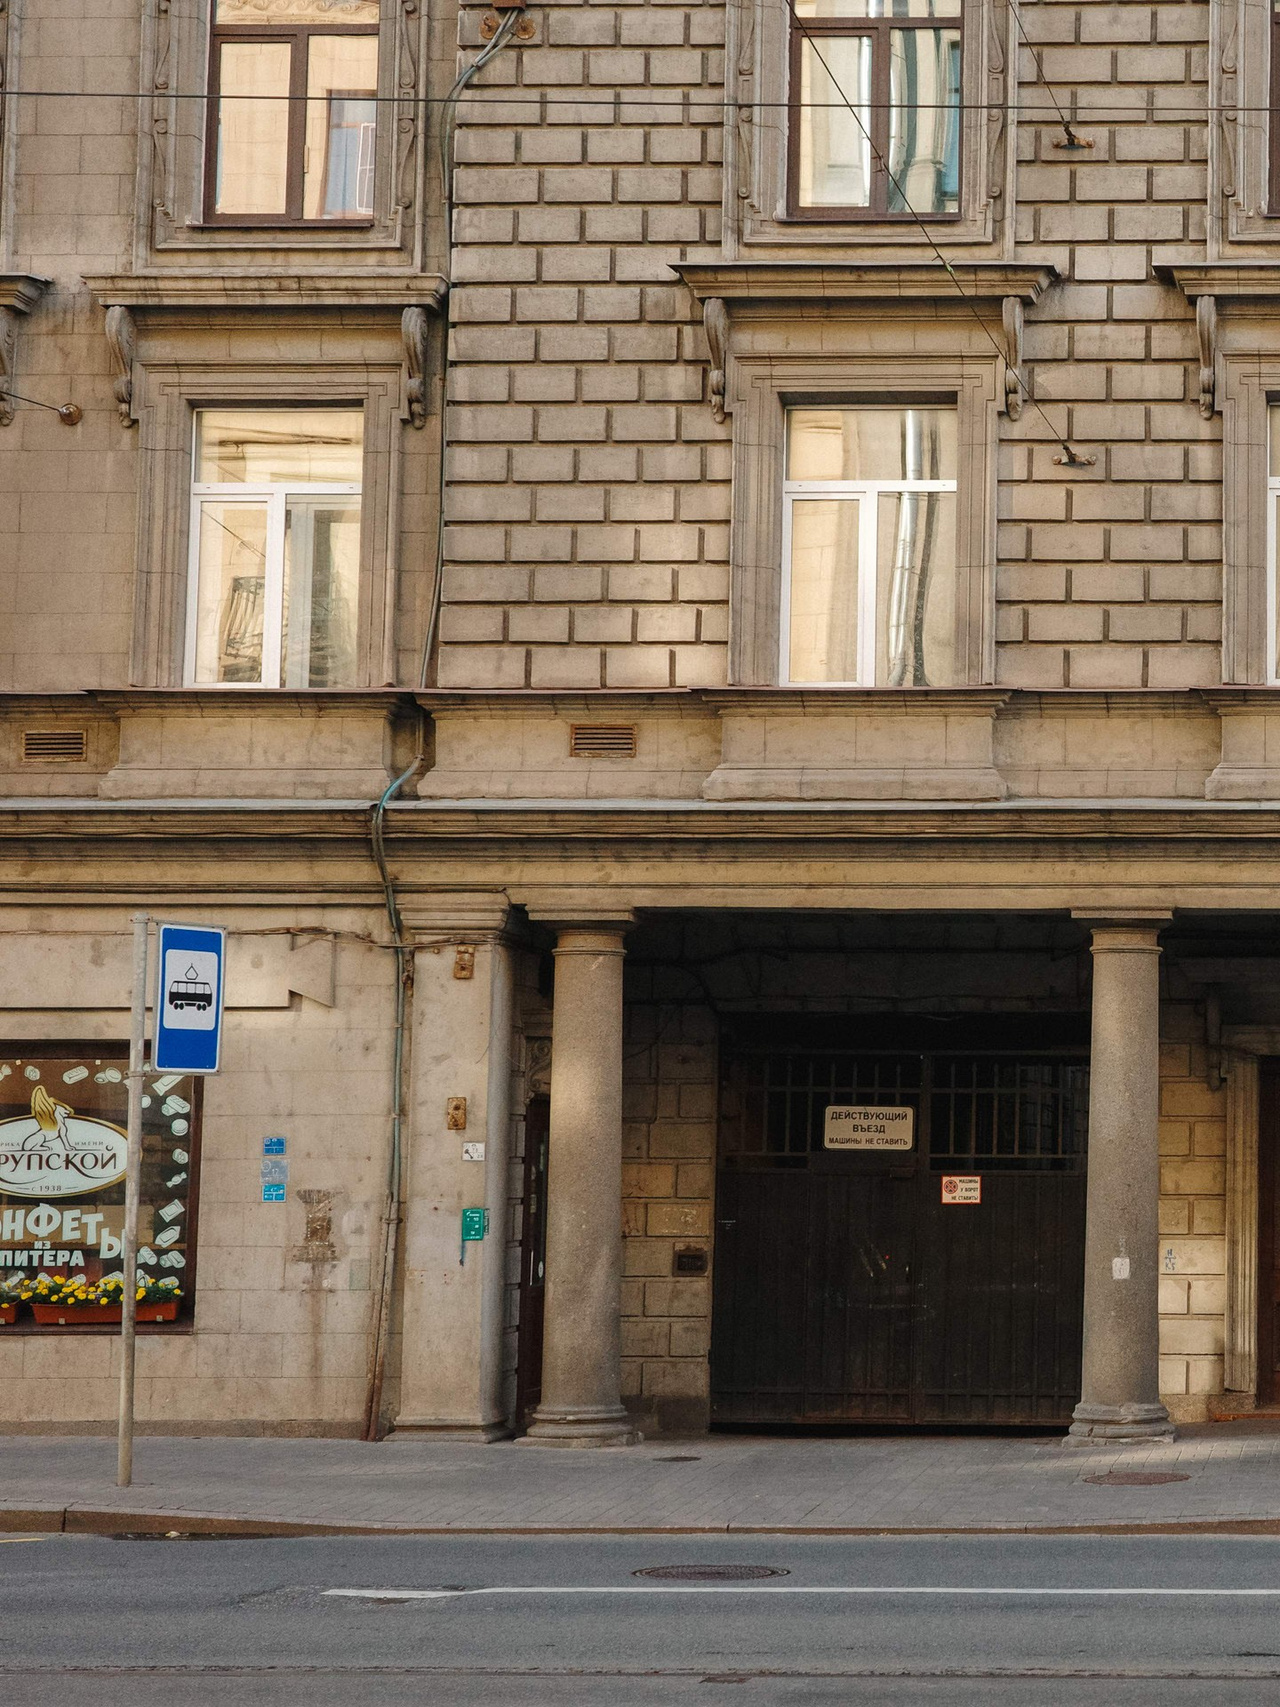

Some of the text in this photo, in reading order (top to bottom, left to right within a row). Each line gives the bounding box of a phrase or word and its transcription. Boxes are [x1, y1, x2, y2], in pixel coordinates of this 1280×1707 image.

[831, 1110, 907, 1122] ДЕЙСТВУЮЩИЙ
[852, 1124, 886, 1134] ВЪЕЗД
[828, 1137, 862, 1145] МАШИНЫ
[876, 1138, 908, 1146] СТАВИТЬ
[0, 1145, 118, 1172] РУПСКОЙ
[0, 1203, 126, 1259] НФЕТЫ
[0, 1250, 85, 1266] ПИТЕРА
